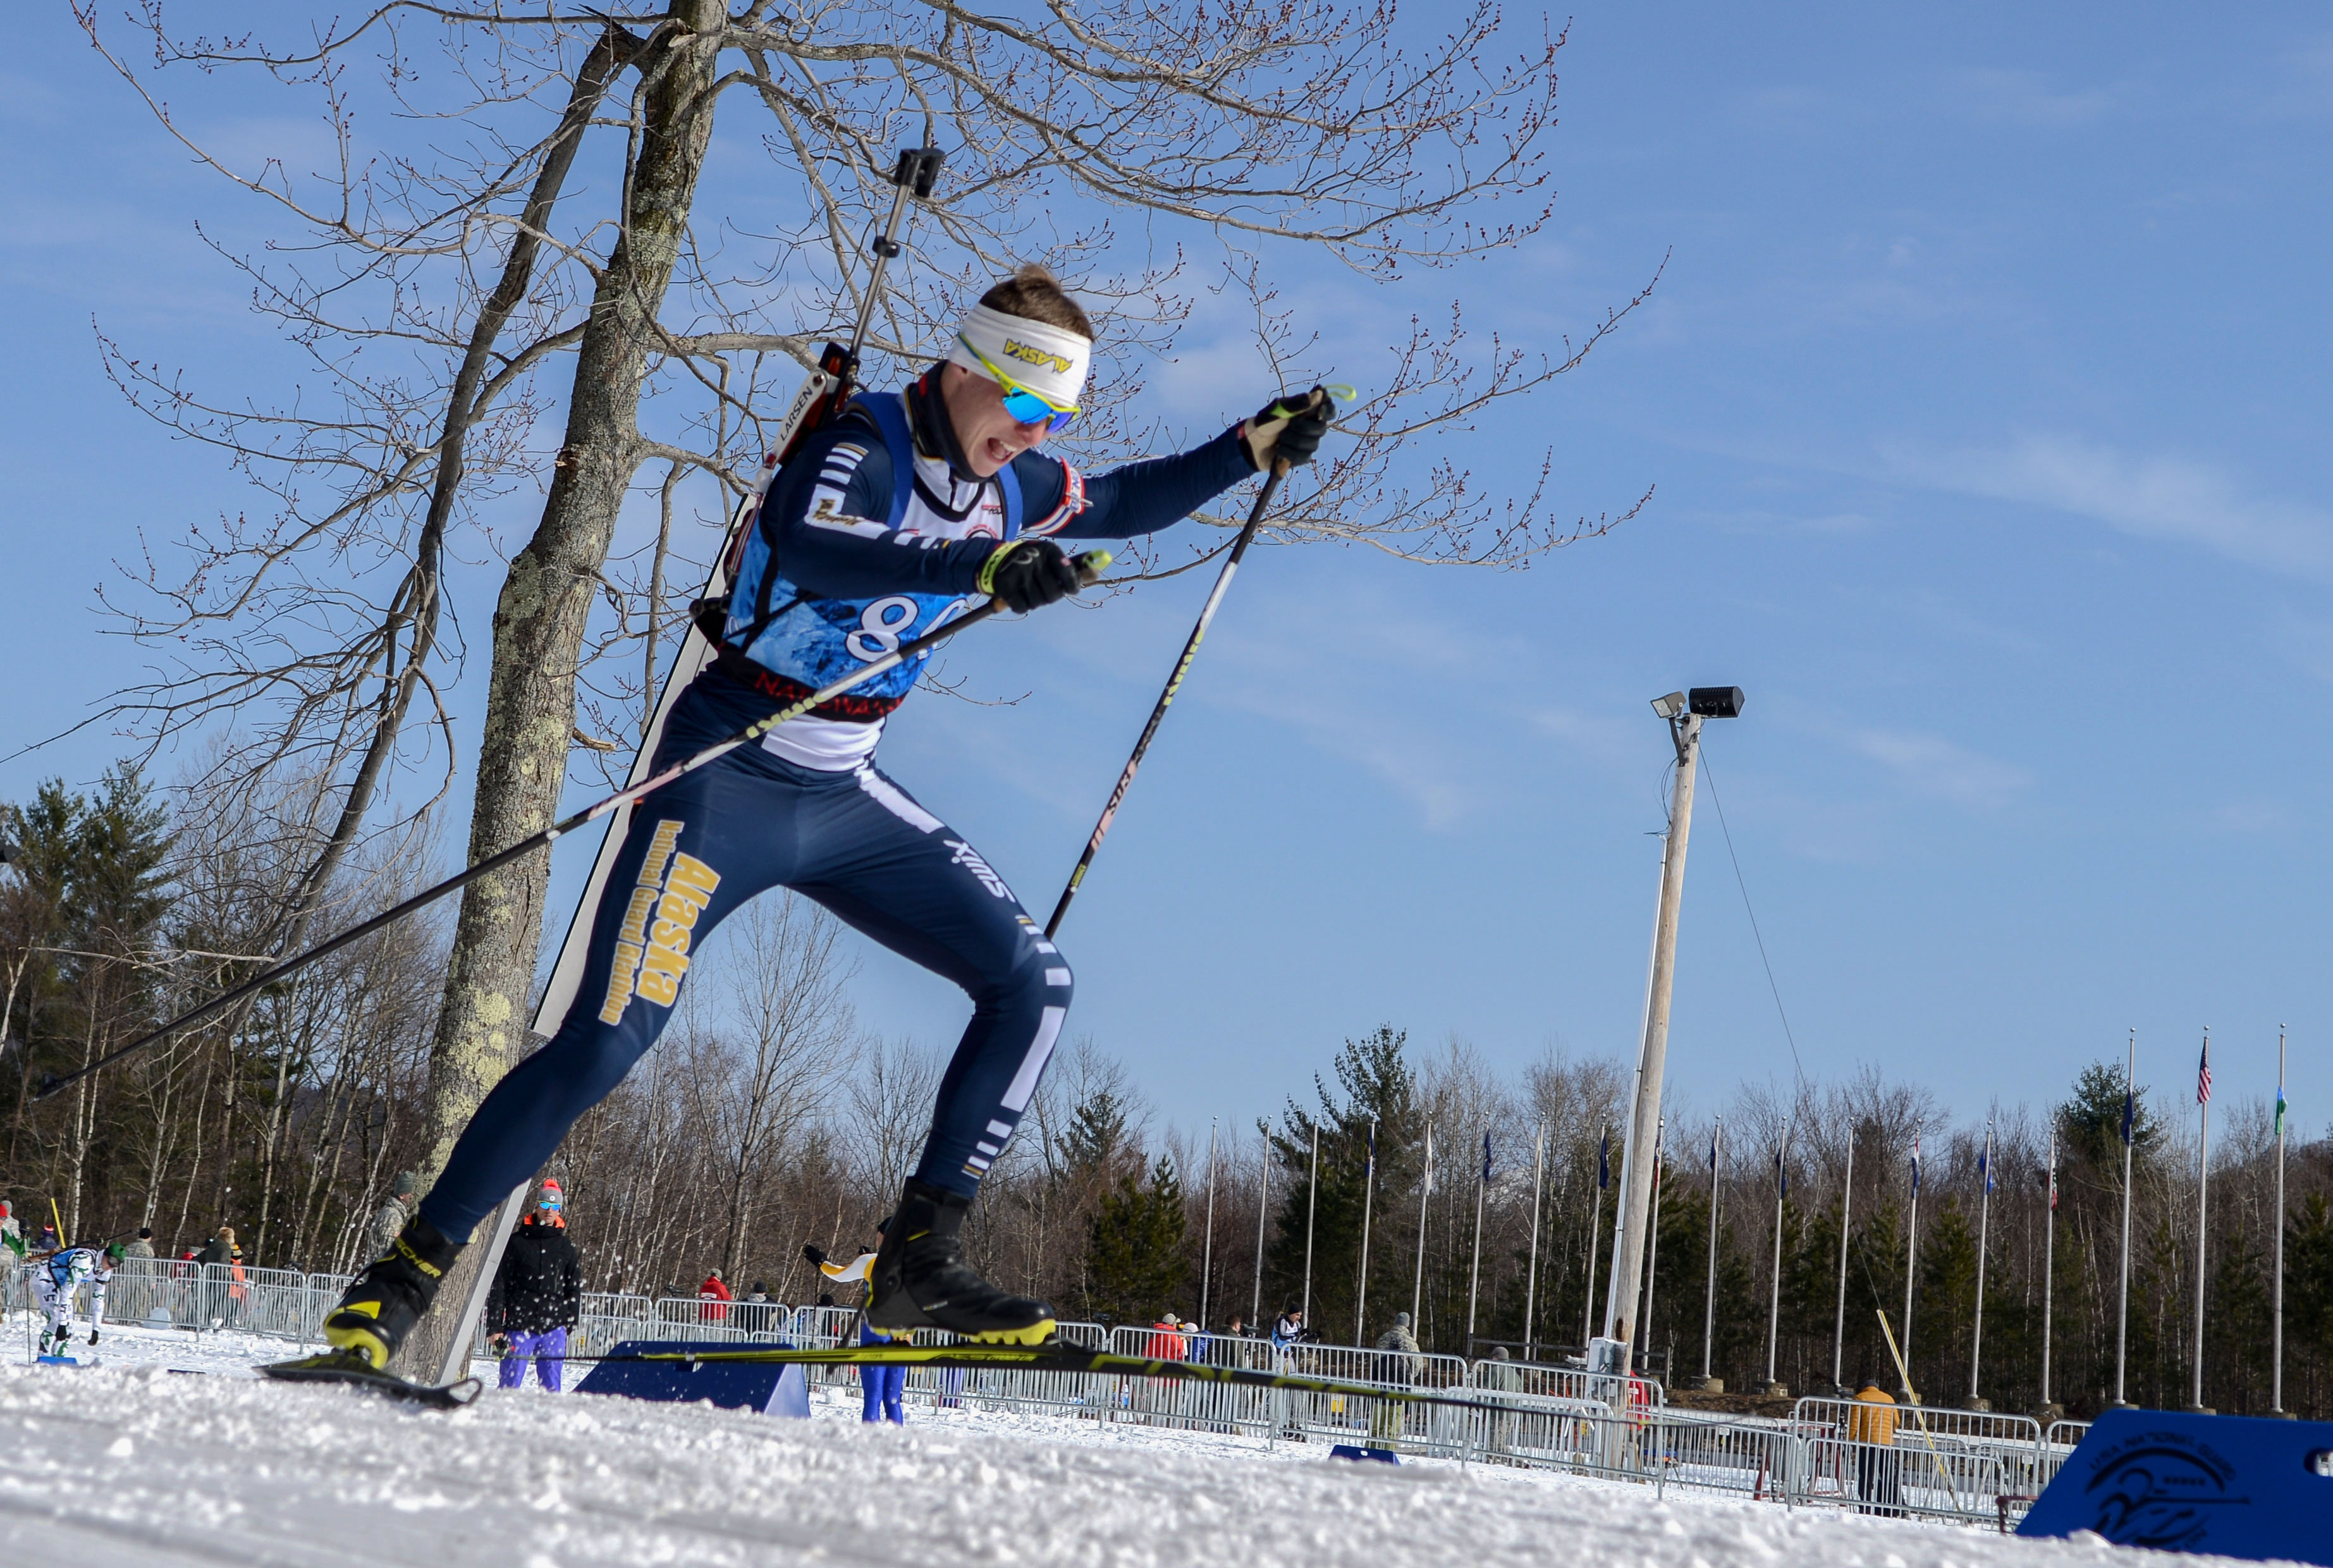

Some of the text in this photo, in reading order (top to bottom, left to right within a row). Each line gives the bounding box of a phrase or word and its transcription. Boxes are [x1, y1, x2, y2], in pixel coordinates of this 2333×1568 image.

[1003, 338, 1074, 374] ALASKA
[780, 386, 814, 441] LARSEN
[637, 819, 685, 888] National
[618, 887, 659, 946] Guard
[635, 852, 721, 1008] Alaska
[598, 941, 644, 1026] Biathlon
[395, 1236, 442, 1278] SCHER
